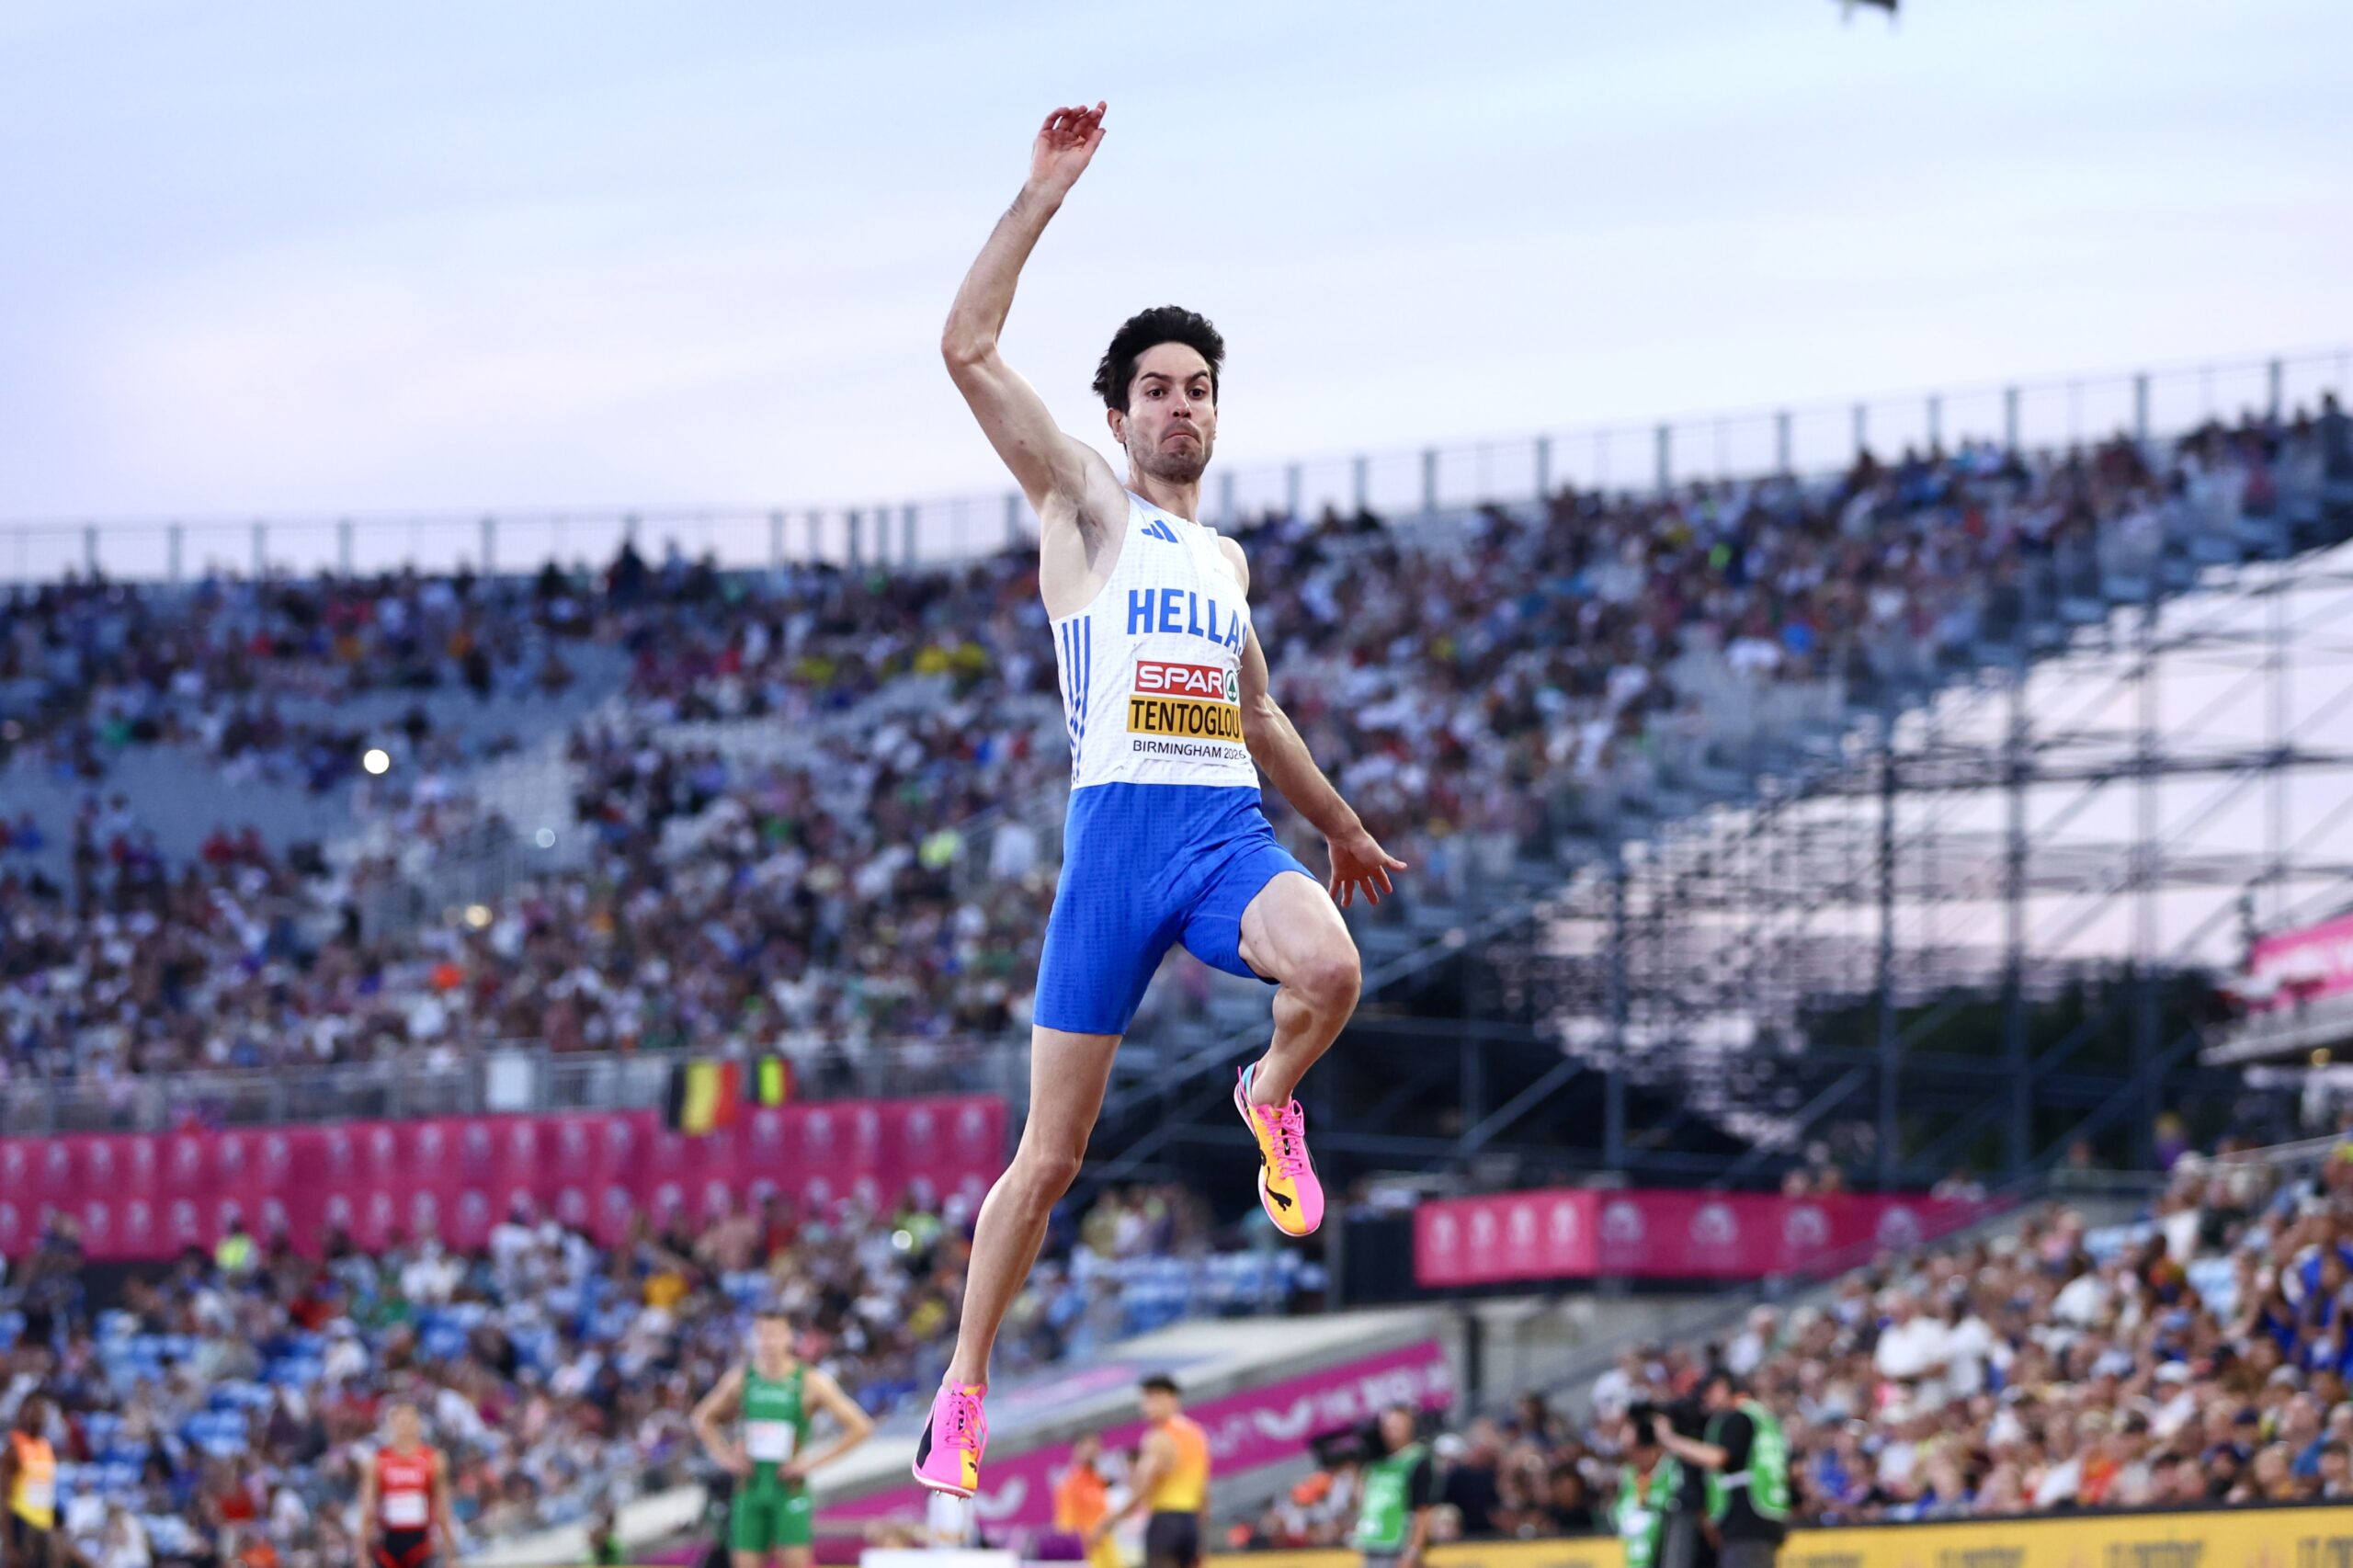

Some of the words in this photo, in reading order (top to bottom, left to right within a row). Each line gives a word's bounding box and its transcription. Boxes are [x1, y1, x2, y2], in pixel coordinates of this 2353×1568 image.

[1139, 665, 1223, 695] SPAR
[1131, 699, 1240, 738] TENTOGLOU
[1132, 740, 1222, 758] BIRMINGHAM
[1223, 747, 1246, 760] 2026
